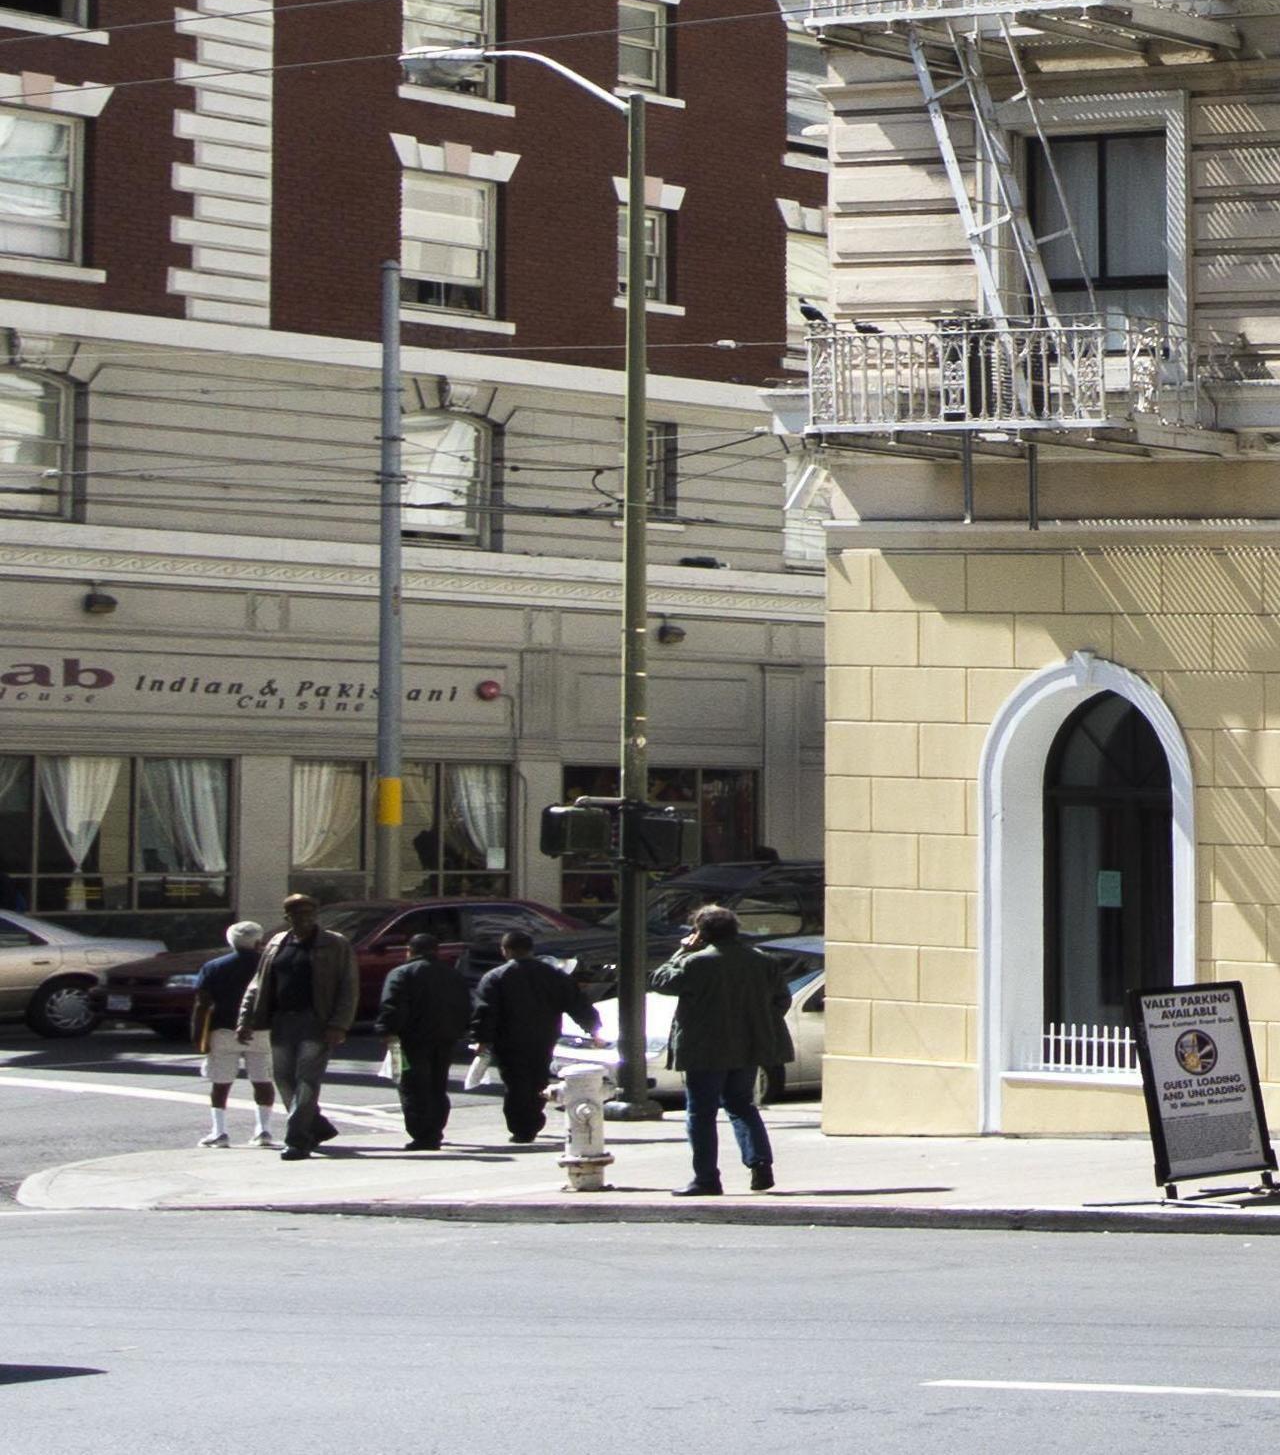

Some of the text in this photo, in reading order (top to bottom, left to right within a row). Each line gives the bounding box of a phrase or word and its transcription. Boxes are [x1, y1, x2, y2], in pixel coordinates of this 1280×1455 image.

[135, 675, 458, 702] Indian & PaKisani
[237, 695, 364, 713] Cuisine
[1144, 993, 1230, 1009] VALET PARKING
[1161, 1006, 1218, 1020] AVAILABLE
[1163, 1074, 1241, 1091] GUEST LOADING
[1163, 1084, 1246, 1102] AND UNLOADING
